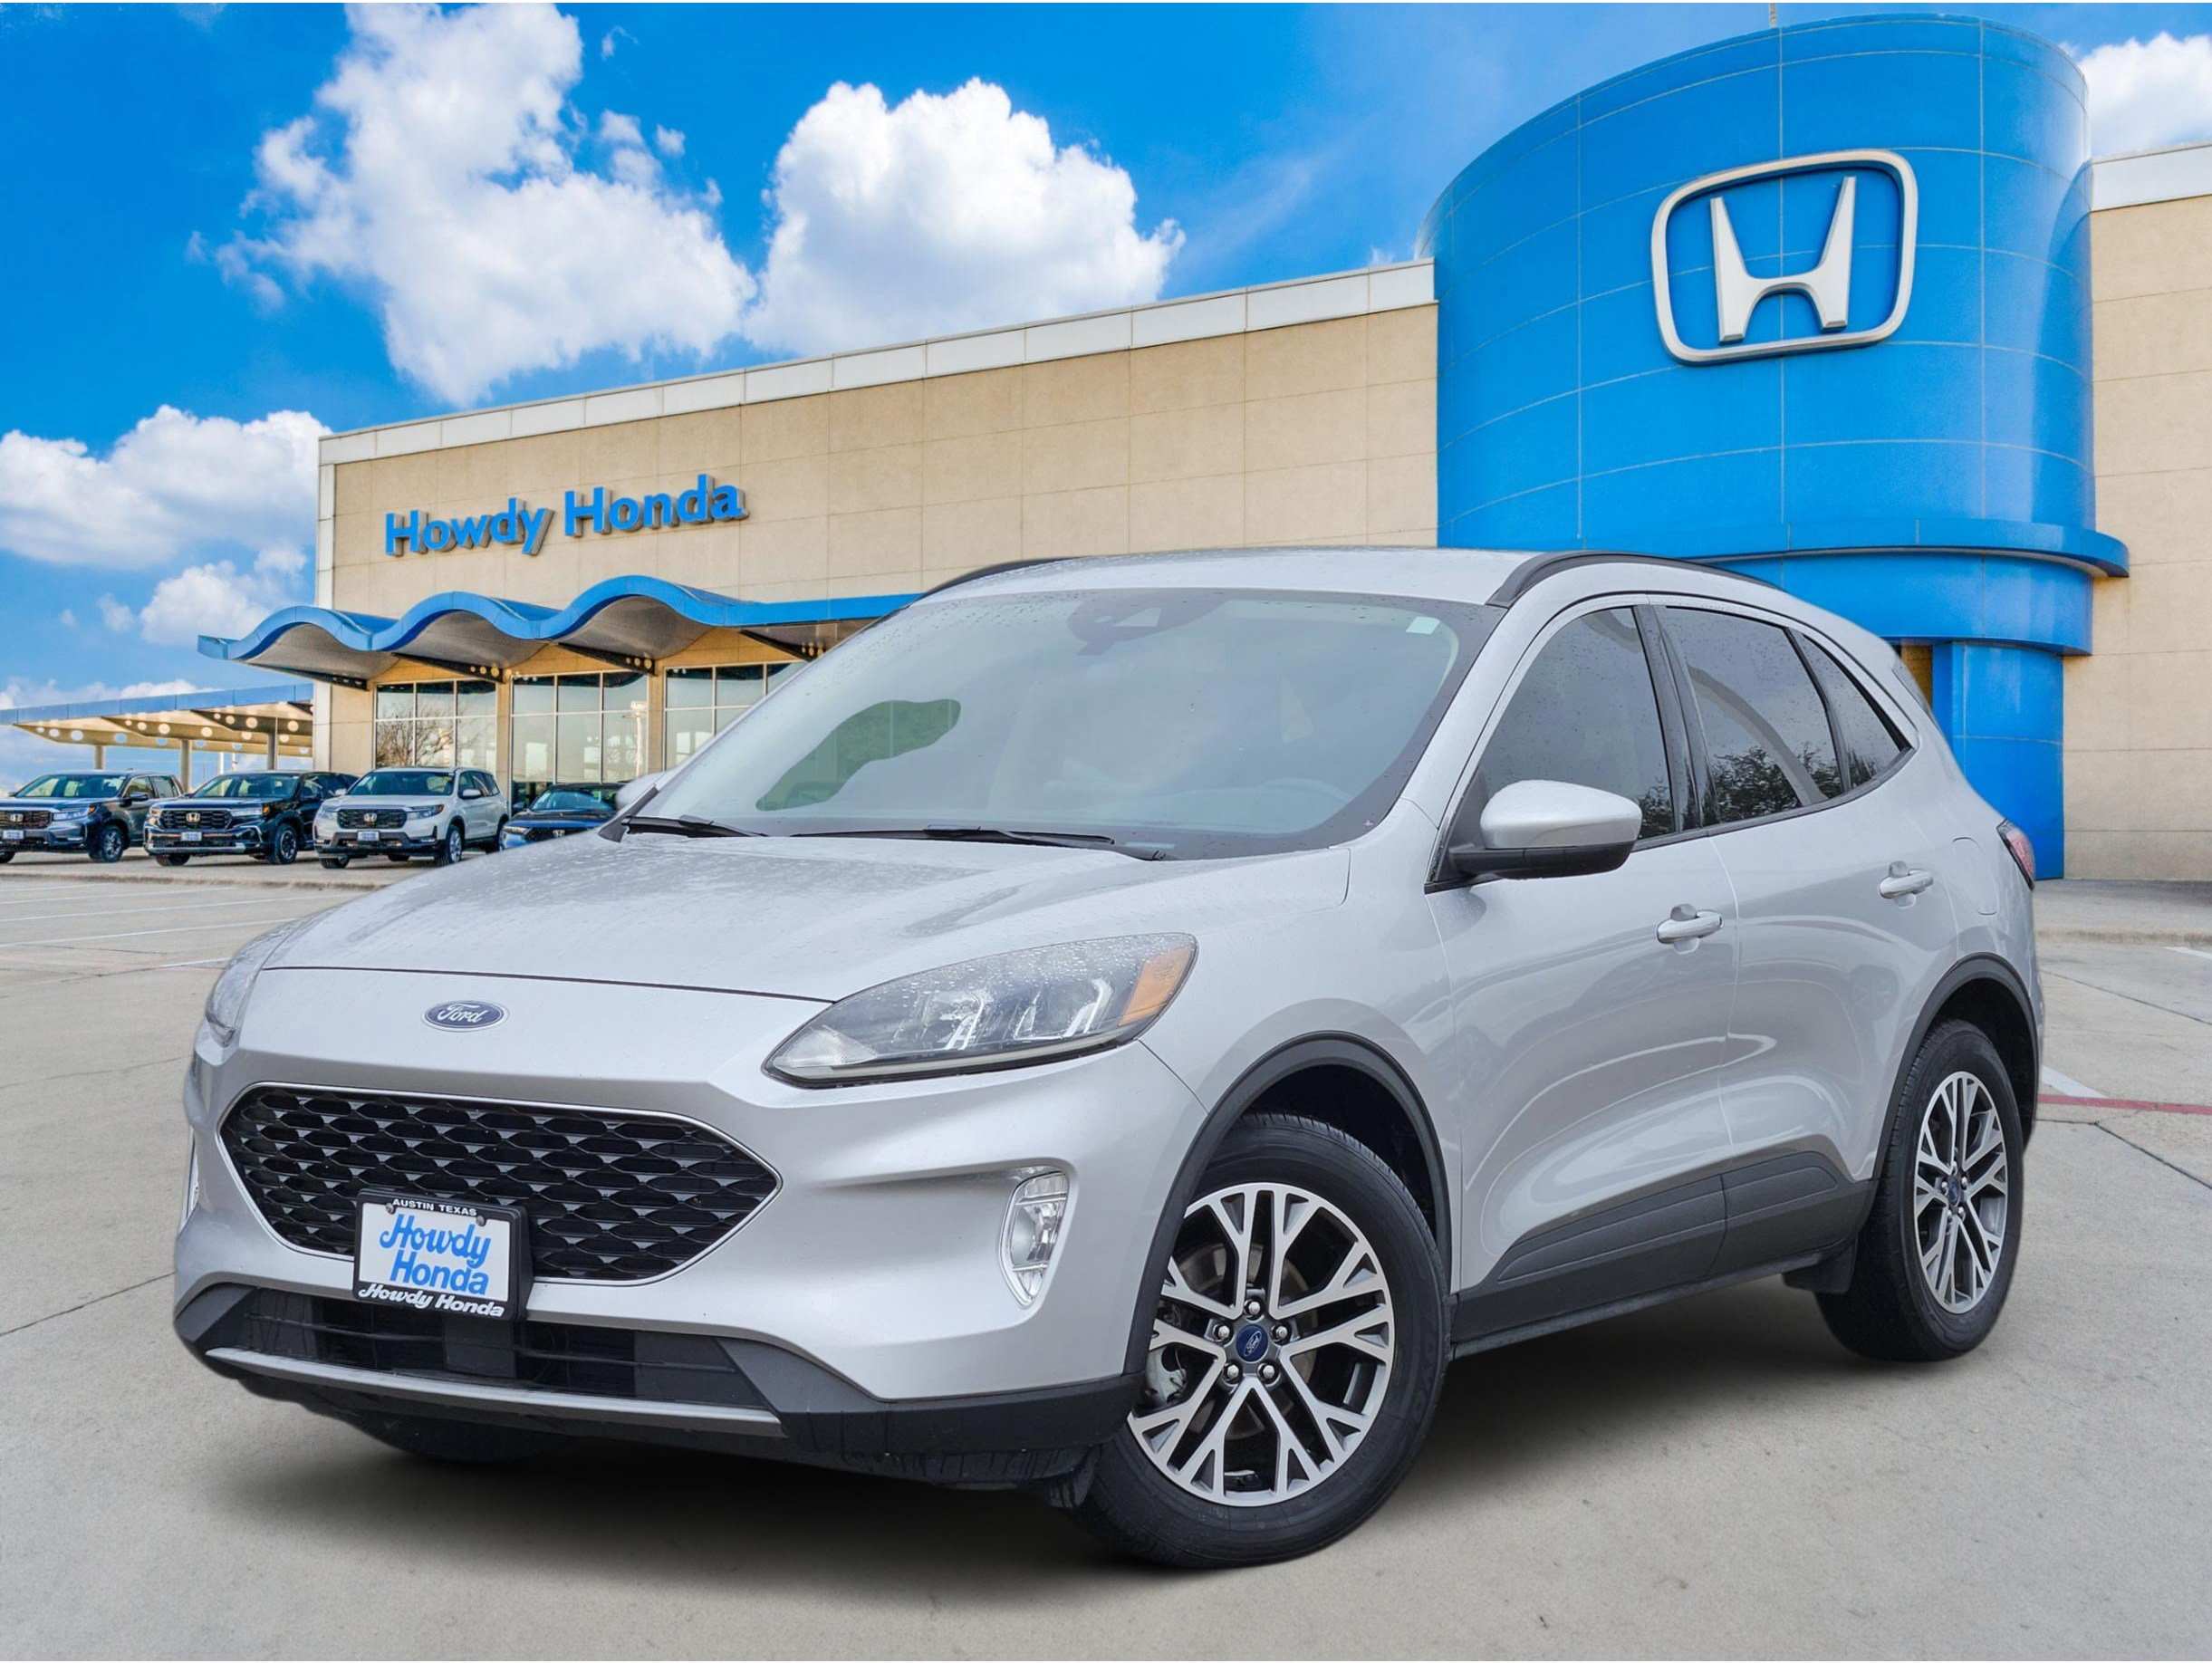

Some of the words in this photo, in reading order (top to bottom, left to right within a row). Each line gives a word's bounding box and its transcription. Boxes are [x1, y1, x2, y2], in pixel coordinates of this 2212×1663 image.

[385, 497, 553, 556] Howdy
[564, 474, 749, 537] Honda
[437, 1003, 488, 1023] Ford
[392, 1198, 435, 1211] AUSTIN
[438, 1204, 477, 1216] TEXAS
[380, 1213, 492, 1269] Howdy
[390, 1249, 490, 1295] Honda
[358, 1283, 434, 1309] Howdy
[435, 1293, 505, 1318] Honda
